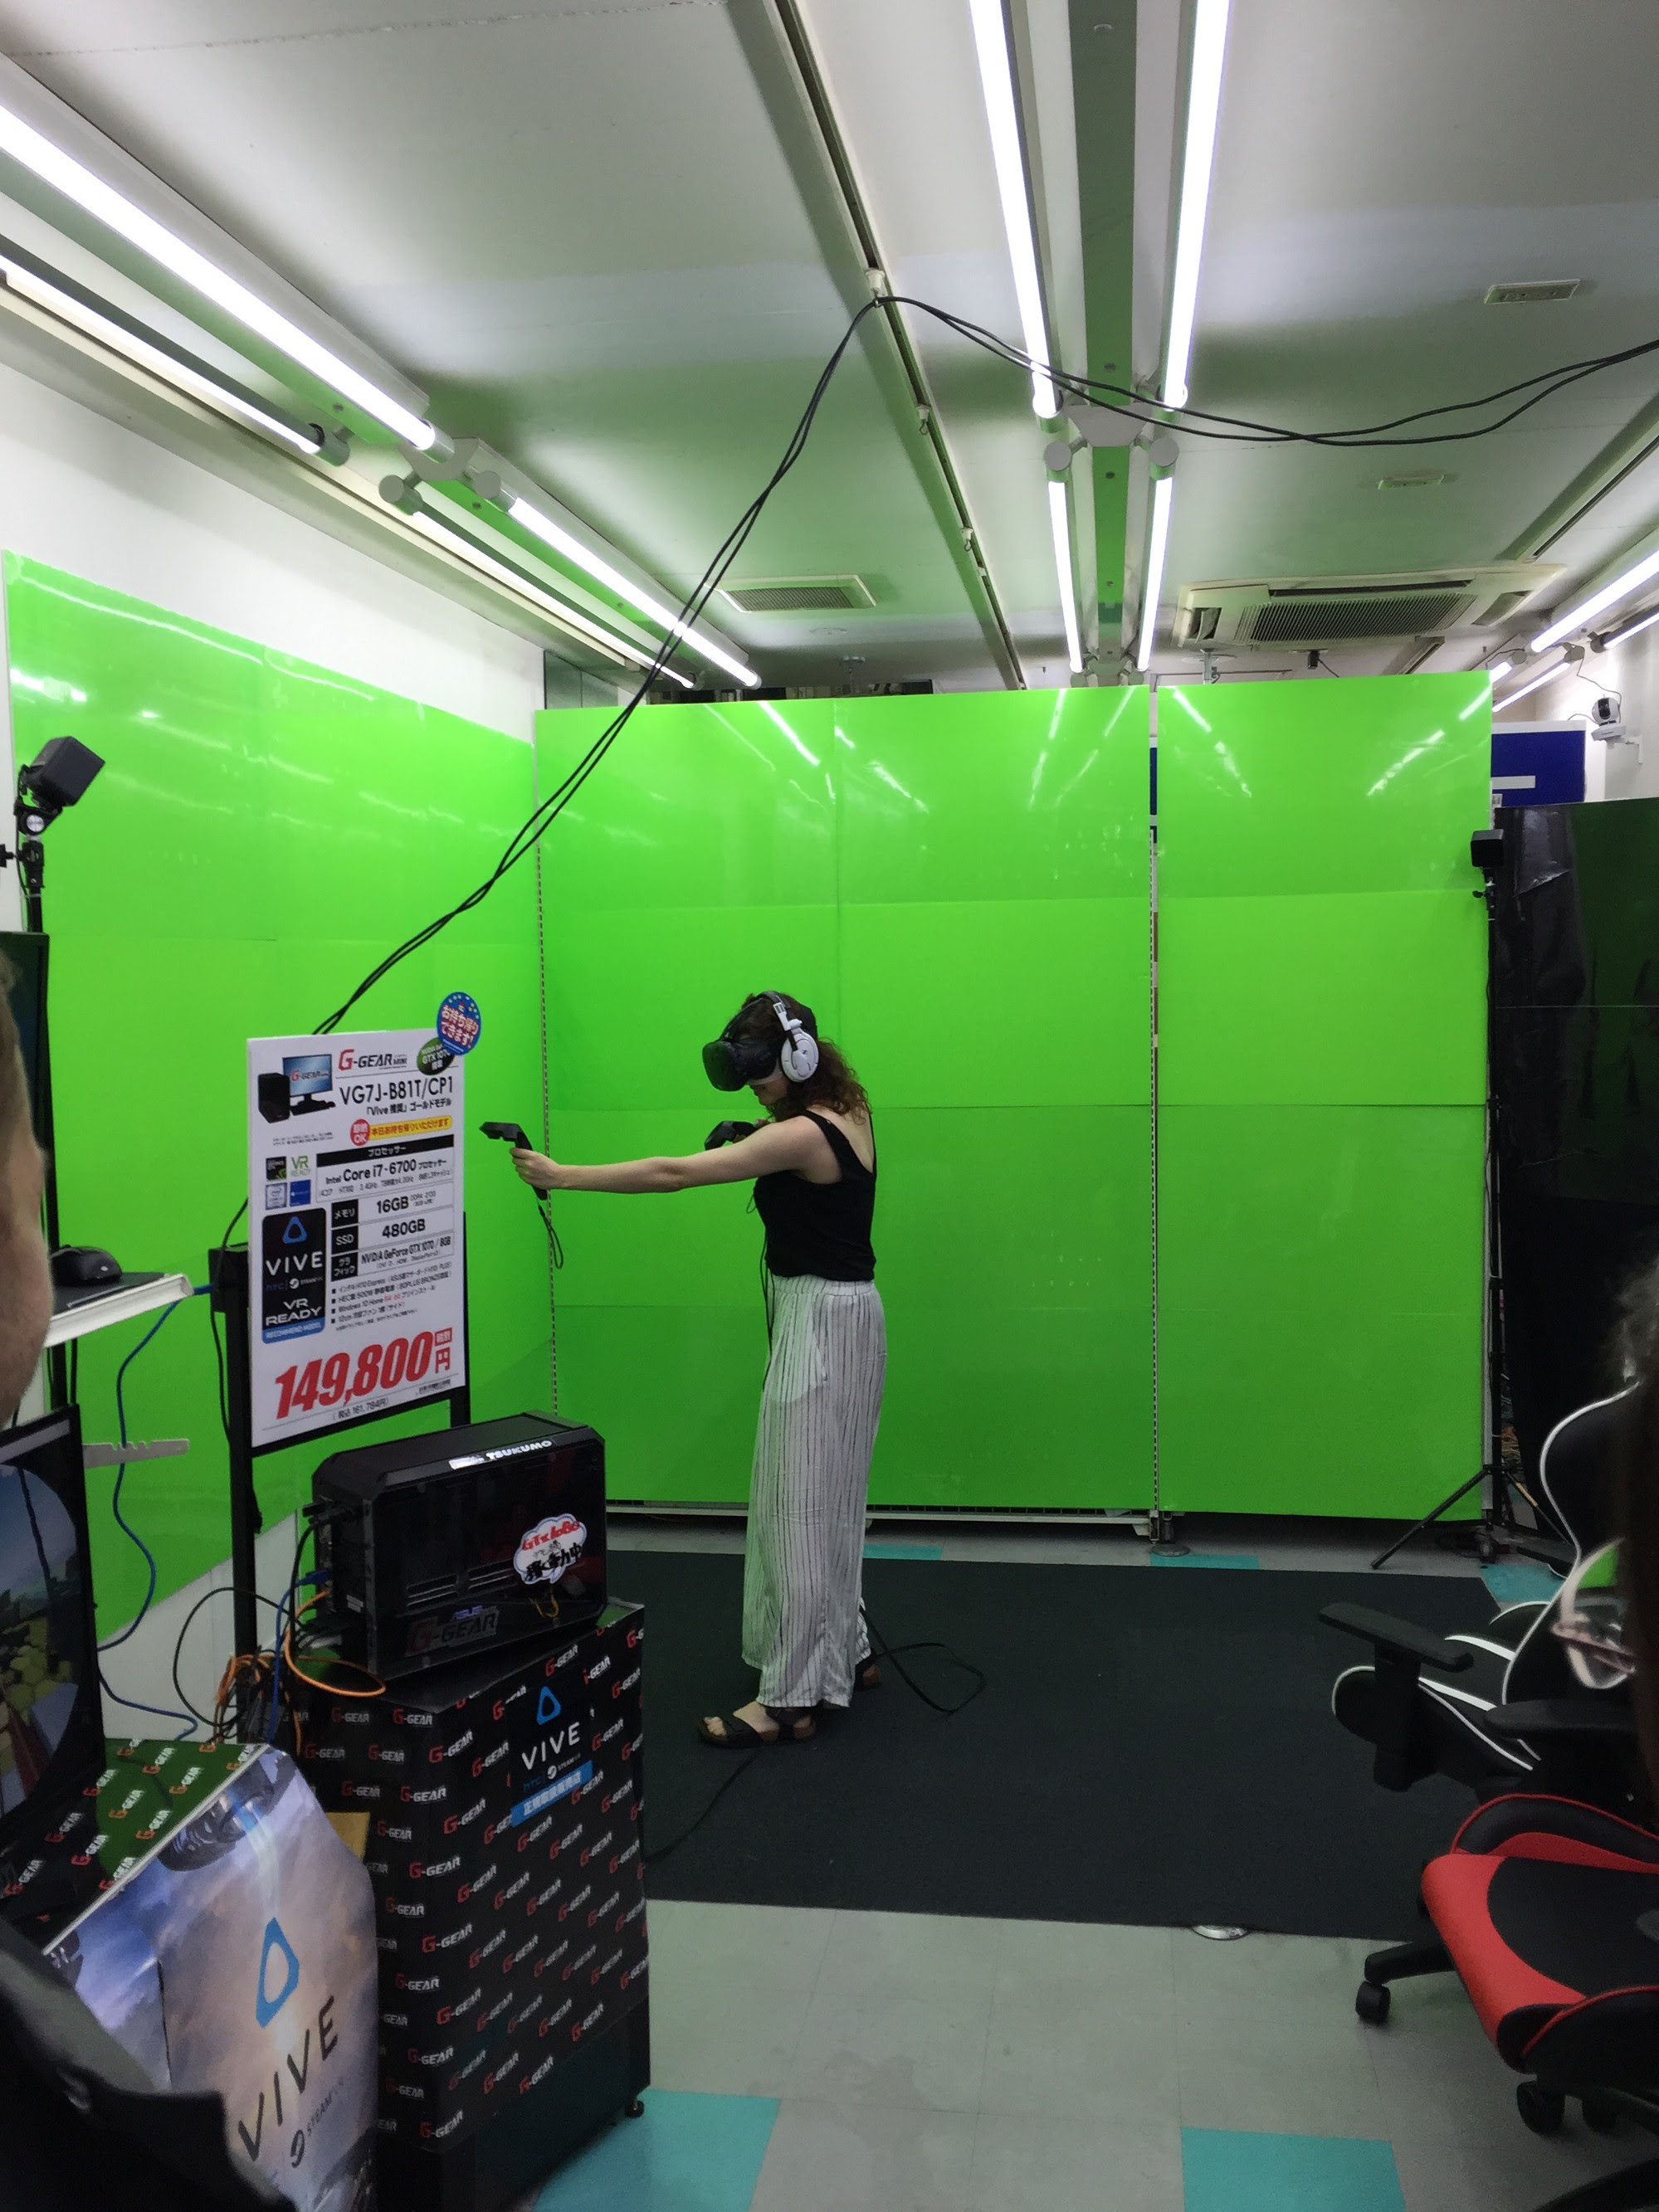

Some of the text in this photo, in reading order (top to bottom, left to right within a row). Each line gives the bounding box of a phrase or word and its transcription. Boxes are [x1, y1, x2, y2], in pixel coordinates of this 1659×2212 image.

[339, 1049, 393, 1070] G-GEAR
[339, 1076, 453, 1105] VG7J-B81T/CP1
[354, 1134, 366, 1143] OK
[291, 1155, 309, 1169] VR
[343, 1168, 371, 1182] Core
[334, 1209, 355, 1220] メモリ
[377, 1196, 409, 1214] 16GB
[336, 1234, 354, 1245] SSD
[382, 1219, 426, 1239] 480GB
[266, 1250, 323, 1276] VIVE
[283, 1298, 309, 1310] VR
[266, 1306, 322, 1326] READY
[275, 1331, 451, 1420] 149,800 円
[486, 1440, 553, 1460] TSUKUMO
[545, 1644, 578, 1678] G-GEAR
[392, 1707, 433, 1726] G-GEAR
[304, 1741, 345, 1760] G-GEAR
[368, 1743, 405, 1762] G-GEAR
[428, 1728, 473, 1764] G-GEAR
[521, 1721, 580, 1771] VIVE
[471, 1739, 510, 1778] G-GEAR
[341, 1779, 381, 1798] G-GEAR
[399, 1784, 447, 1803] G-GEAR
[443, 1797, 486, 1835] G-GEAR
[377, 1819, 412, 1839] G-GEAR
[408, 1853, 461, 1878] G-GEAR
[456, 1863, 497, 1903] G-GEAR
[385, 1895, 425, 1917] G-GEAR
[421, 1922, 473, 1953] G-GEAR
[394, 1971, 440, 1992] G-GEAR
[436, 1987, 481, 2025] G-GEAR
[406, 2045, 454, 2065] G-GEAR
[238, 1995, 338, 2161] VIVE
[385, 2077, 424, 2099] G-GEAR
[418, 2110, 463, 2137] G-GEAR
